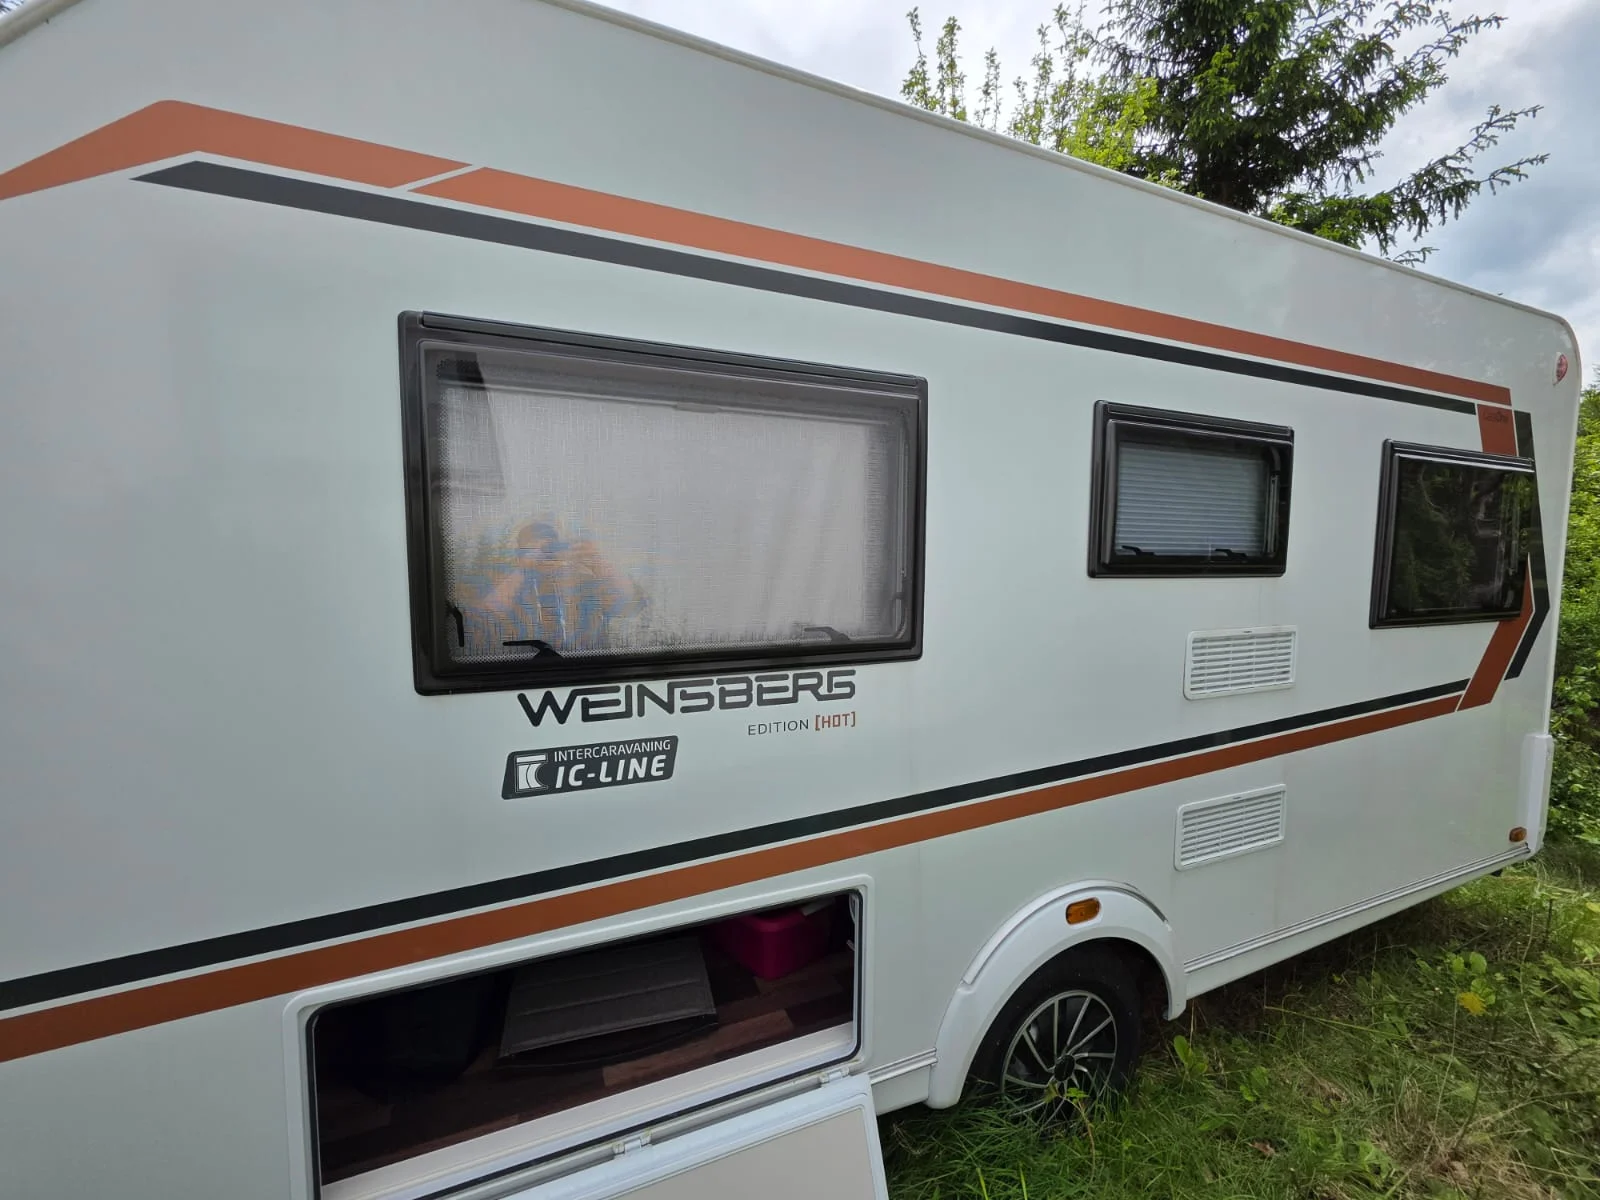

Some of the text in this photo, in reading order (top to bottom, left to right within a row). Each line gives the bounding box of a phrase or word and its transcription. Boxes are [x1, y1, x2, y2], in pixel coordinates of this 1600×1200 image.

[517, 669, 856, 727] WEINSBERG
[748, 711, 856, 736] EDITION [HOT]
[554, 740, 671, 762] INTERCARAVANING
[555, 754, 667, 788] IC-LINE
